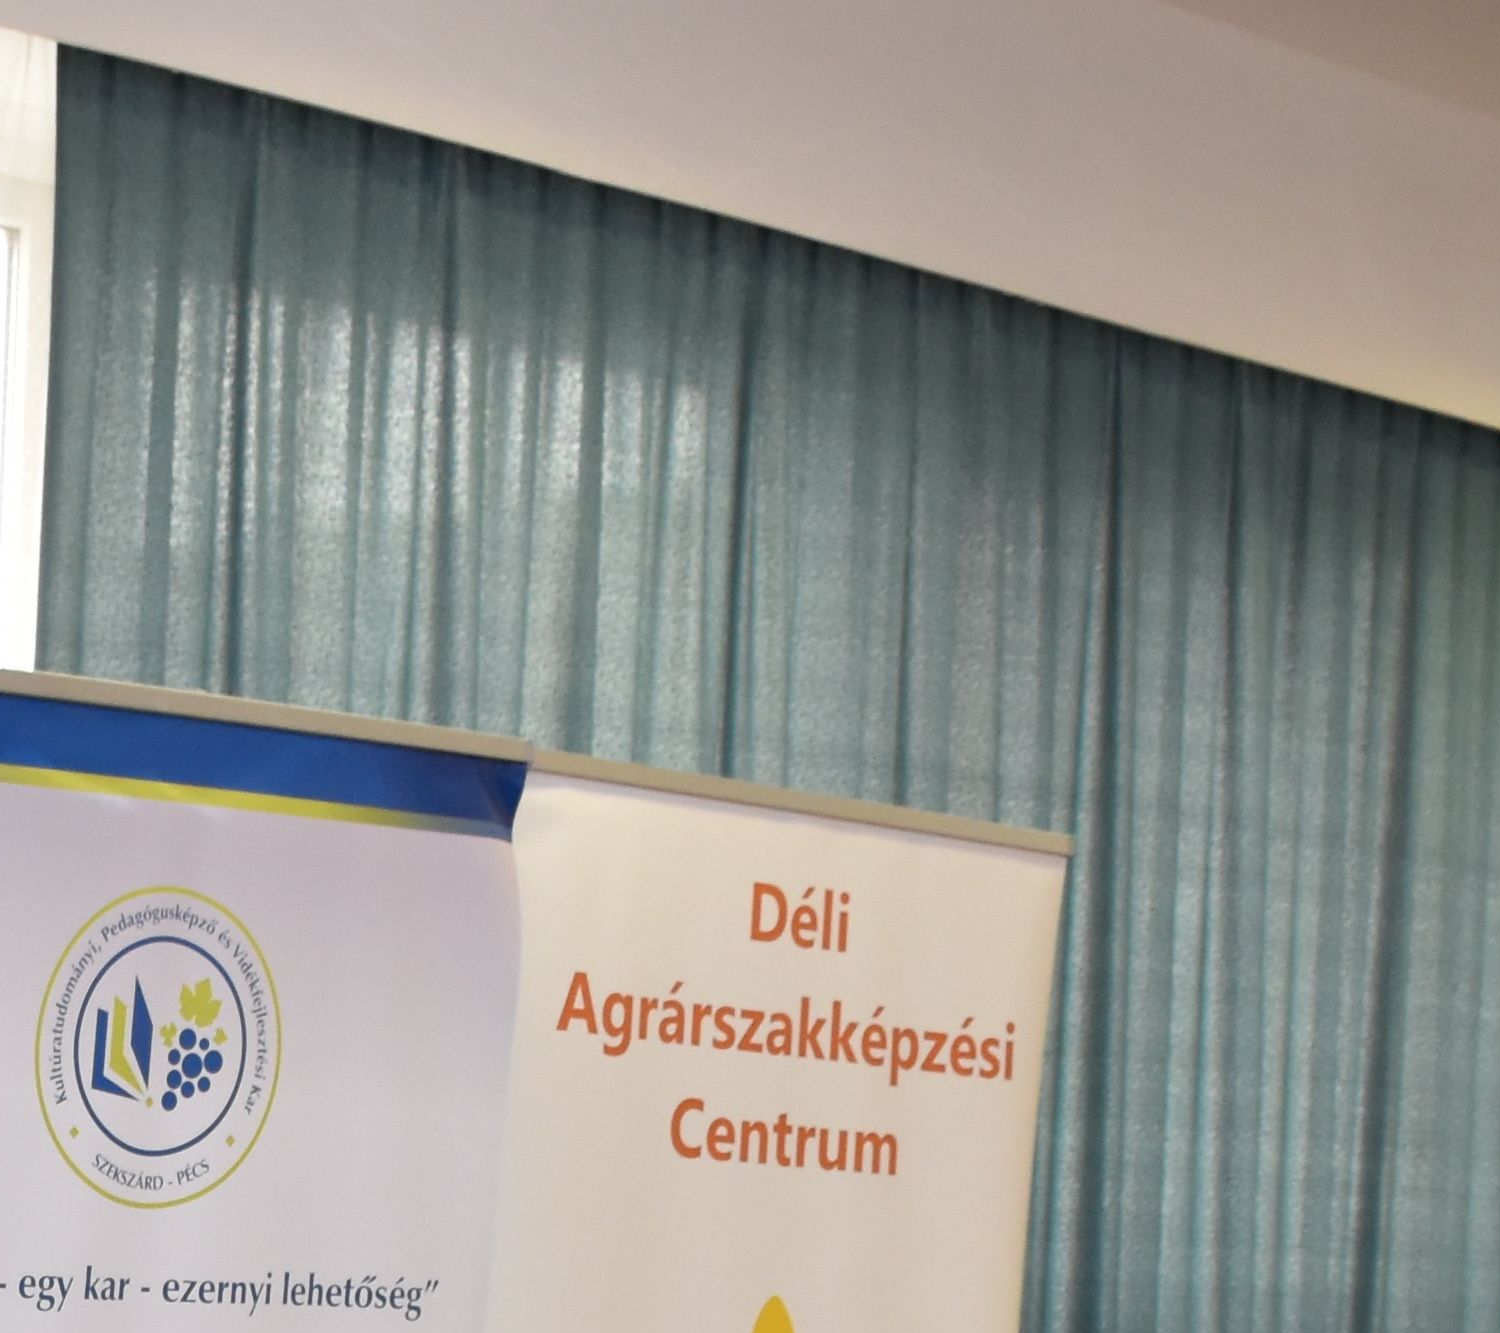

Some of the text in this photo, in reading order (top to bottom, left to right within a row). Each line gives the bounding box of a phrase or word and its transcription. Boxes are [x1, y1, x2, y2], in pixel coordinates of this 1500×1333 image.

[749, 882, 851, 954] Déli
[50, 904, 269, 1114] Kultúratudományi, Pedagógusképző és Vidékfejlesztési Kar
[556, 971, 1016, 1087] Agrárszakképzési
[92, 1153, 164, 1191] SZEKSZÁRD
[176, 1158, 211, 1186] PÉCS
[669, 1098, 899, 1176] Centrum
[18, 1271, 75, 1312] egy
[84, 1266, 131, 1302] kar
[161, 1272, 273, 1316] ezernyi
